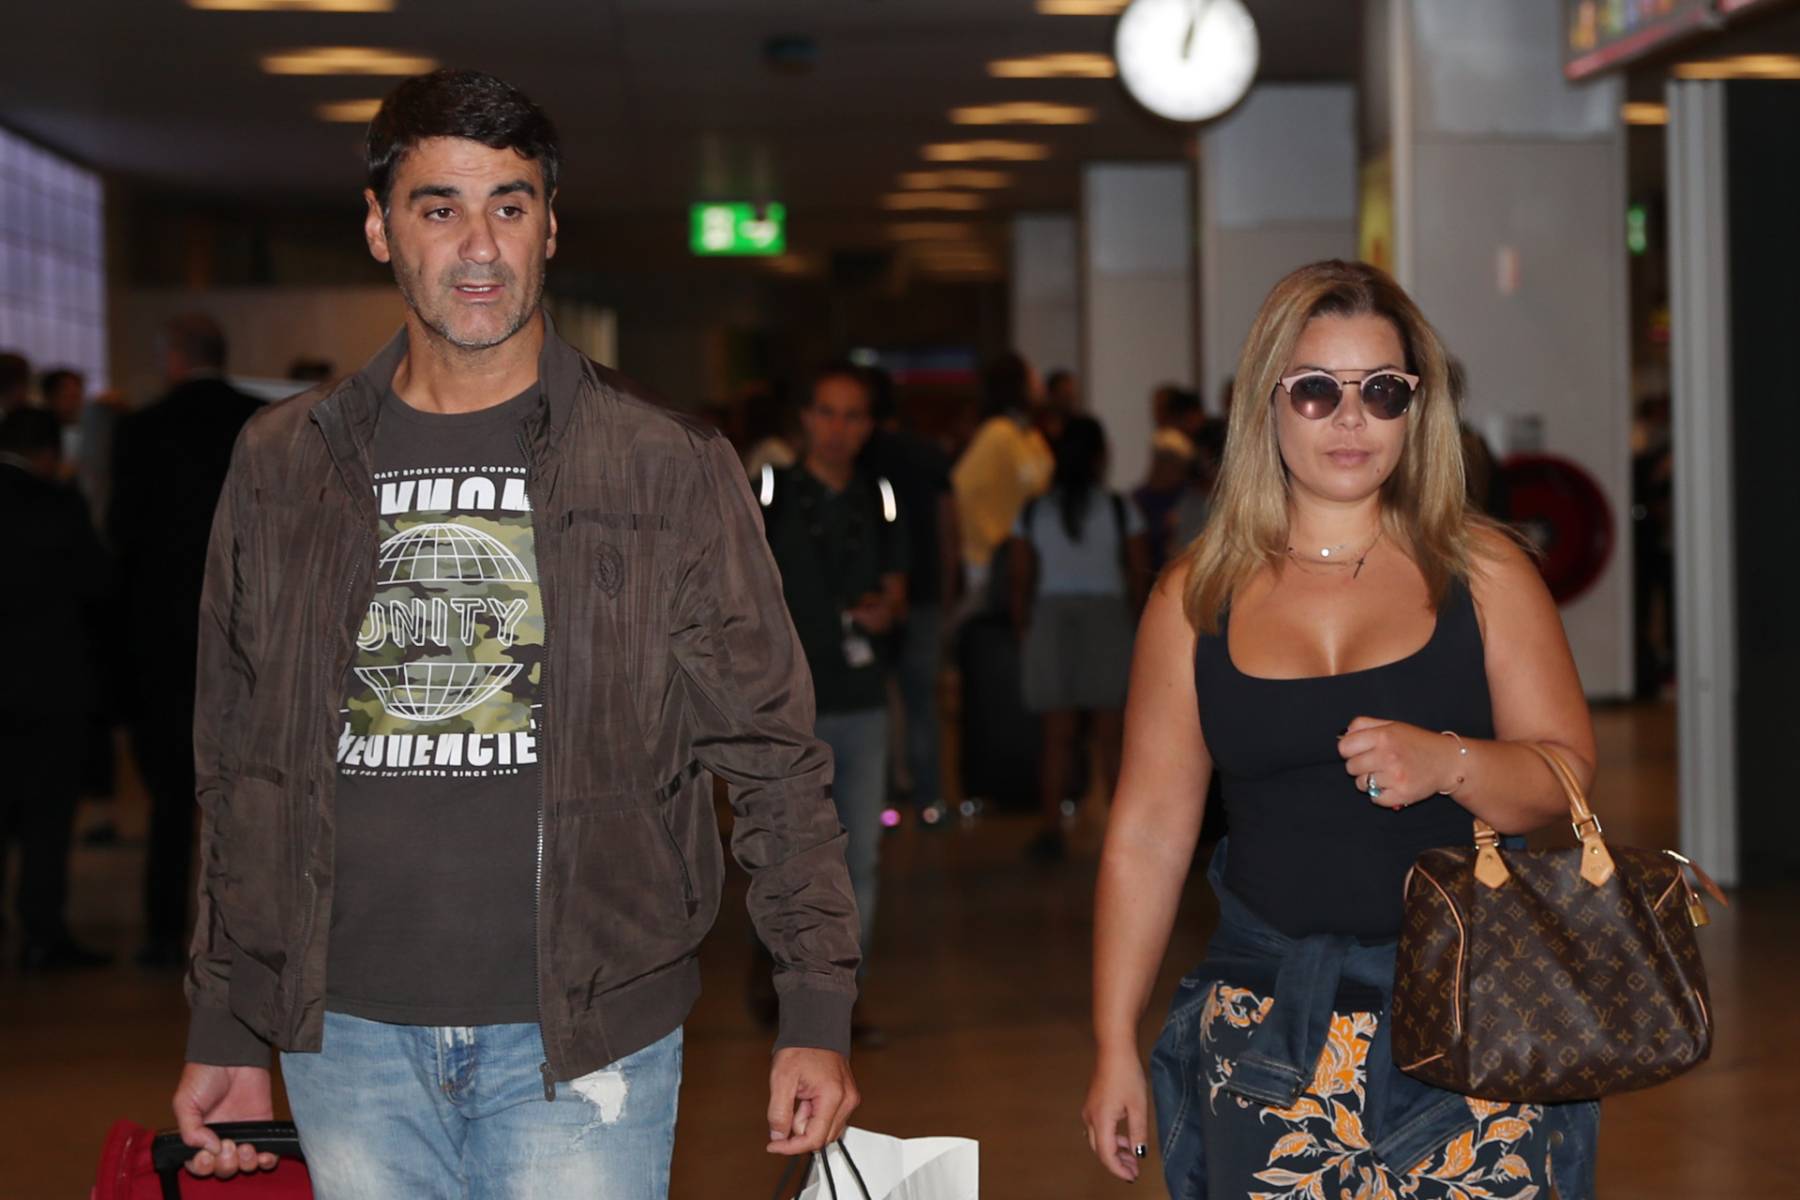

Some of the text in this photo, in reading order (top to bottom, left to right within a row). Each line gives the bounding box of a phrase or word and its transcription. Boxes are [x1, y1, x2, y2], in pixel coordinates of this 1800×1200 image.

[374, 465, 527, 480] OAST SPORTSWEAR CORPOR
[452, 769, 487, 778] SINCE
